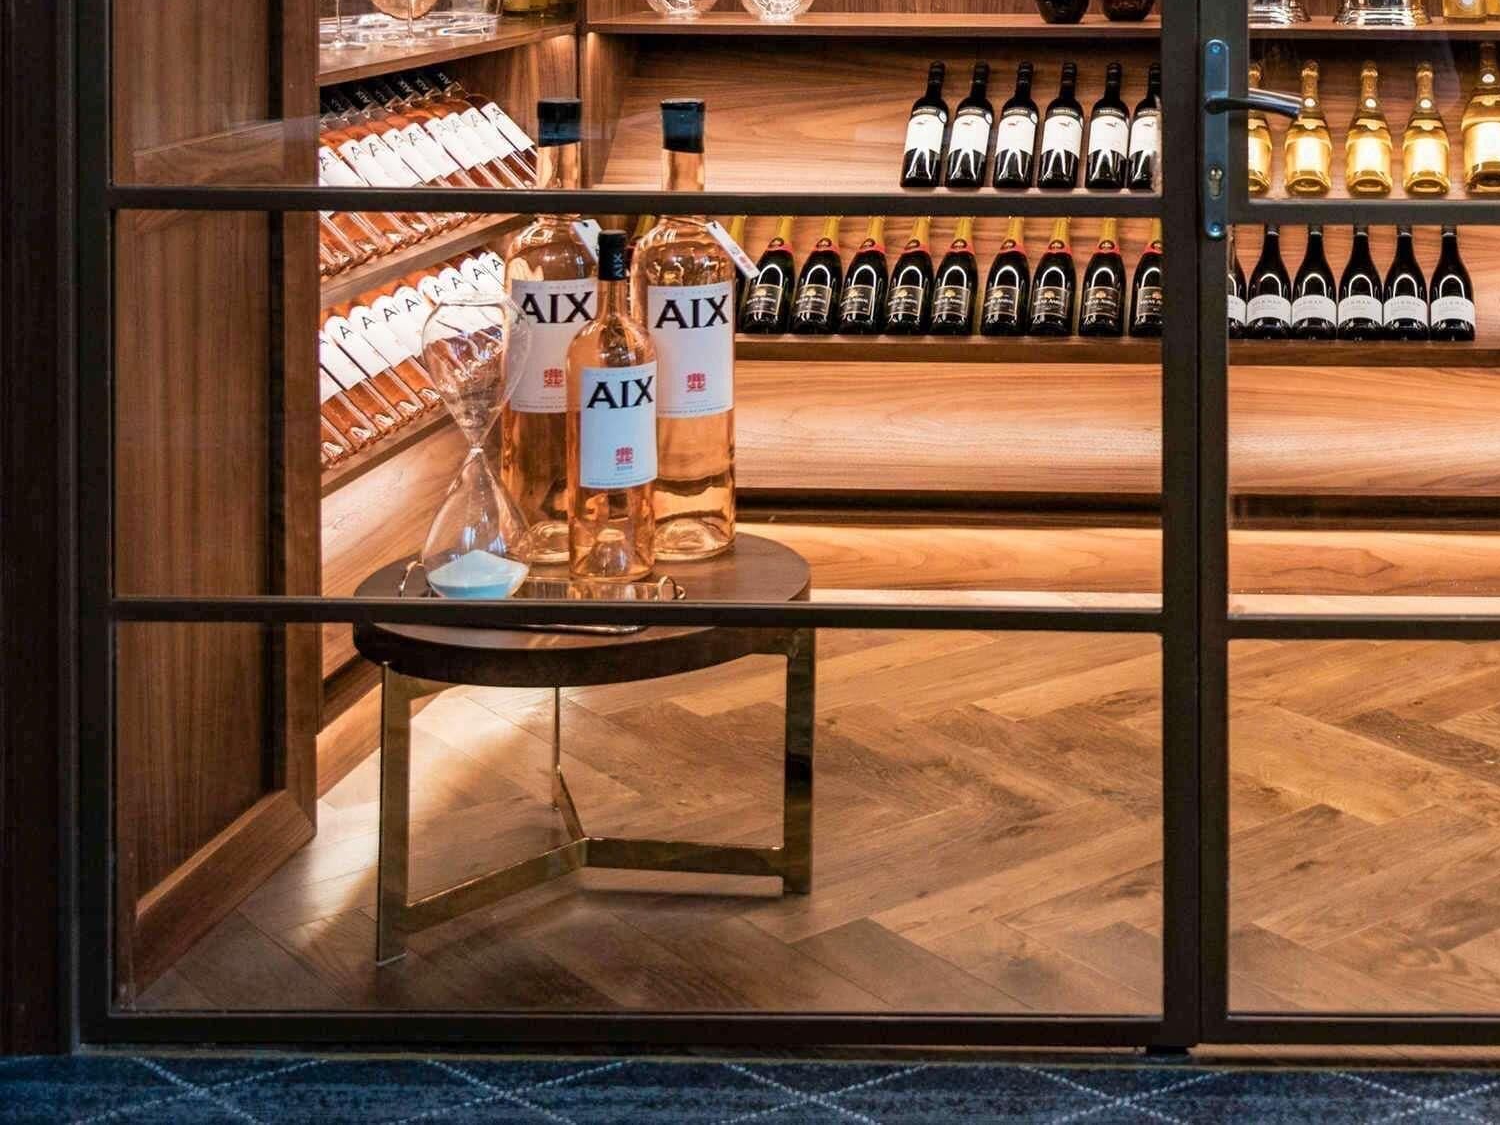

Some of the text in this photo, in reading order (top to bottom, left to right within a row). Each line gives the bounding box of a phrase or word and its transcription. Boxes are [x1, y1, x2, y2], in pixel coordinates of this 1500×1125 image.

[515, 291, 595, 324] AIX
[654, 294, 729, 330] AIX
[586, 375, 654, 409] AIX
